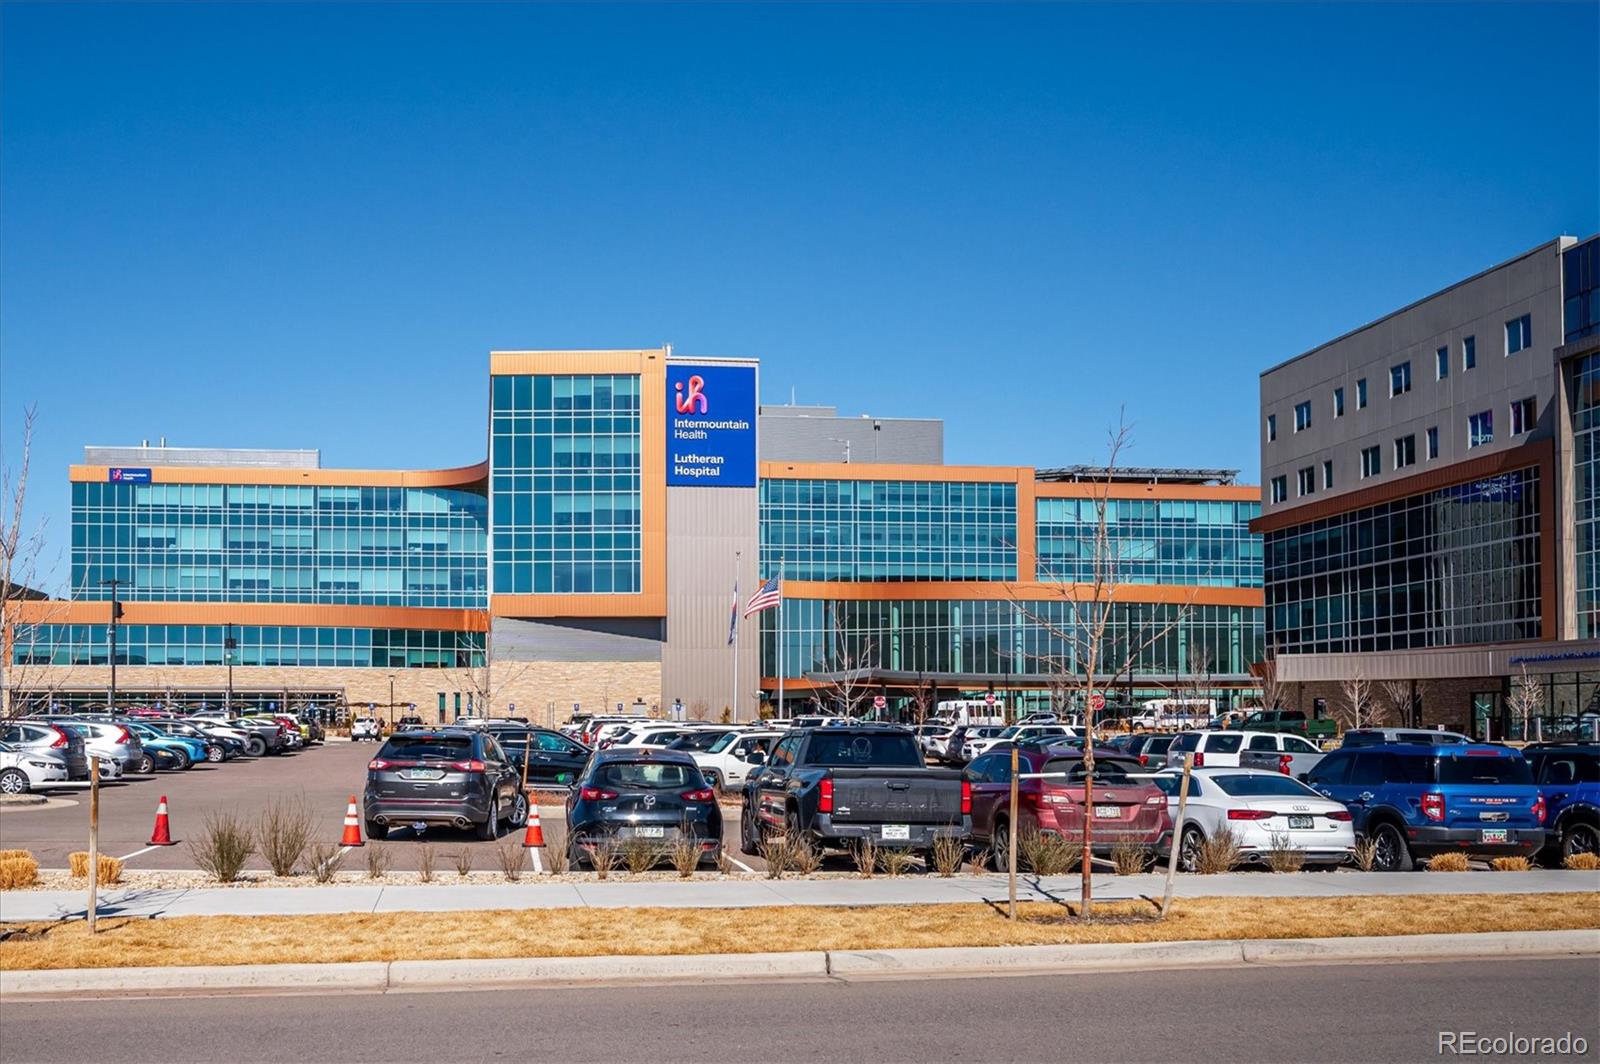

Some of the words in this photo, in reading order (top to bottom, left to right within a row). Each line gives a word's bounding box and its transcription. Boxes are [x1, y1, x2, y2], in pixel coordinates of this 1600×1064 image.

[674, 419, 749, 429] Intermountain
[674, 430, 708, 439] Health
[674, 454, 724, 464] Lutheran
[674, 466, 720, 478] Hospital
